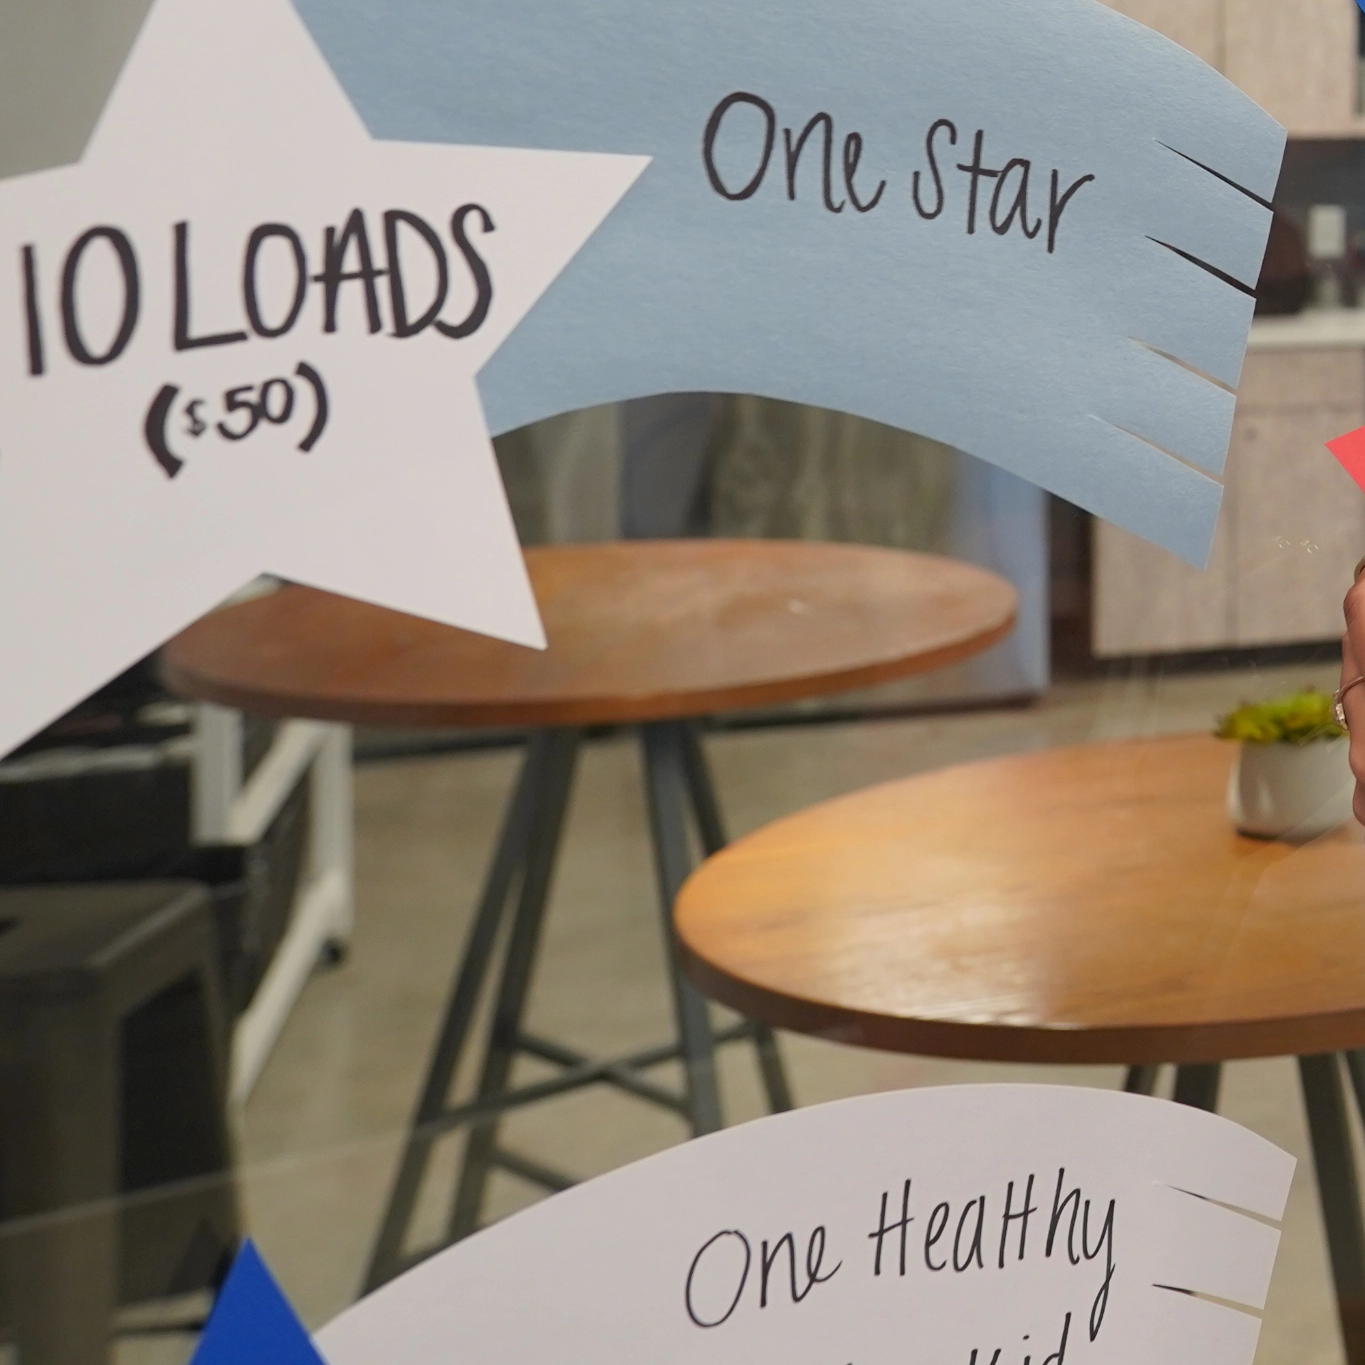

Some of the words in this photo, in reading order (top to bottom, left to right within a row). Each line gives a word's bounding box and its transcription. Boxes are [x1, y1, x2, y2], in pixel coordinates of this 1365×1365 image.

[702, 90, 887, 215] One
[910, 117, 1097, 256] Star
[19, 222, 143, 380] 10
[169, 201, 498, 354] LOADS
[141, 358, 332, 482] ($50)
[684, 1223, 845, 1330] One
[866, 1166, 1117, 1344] Healthy
